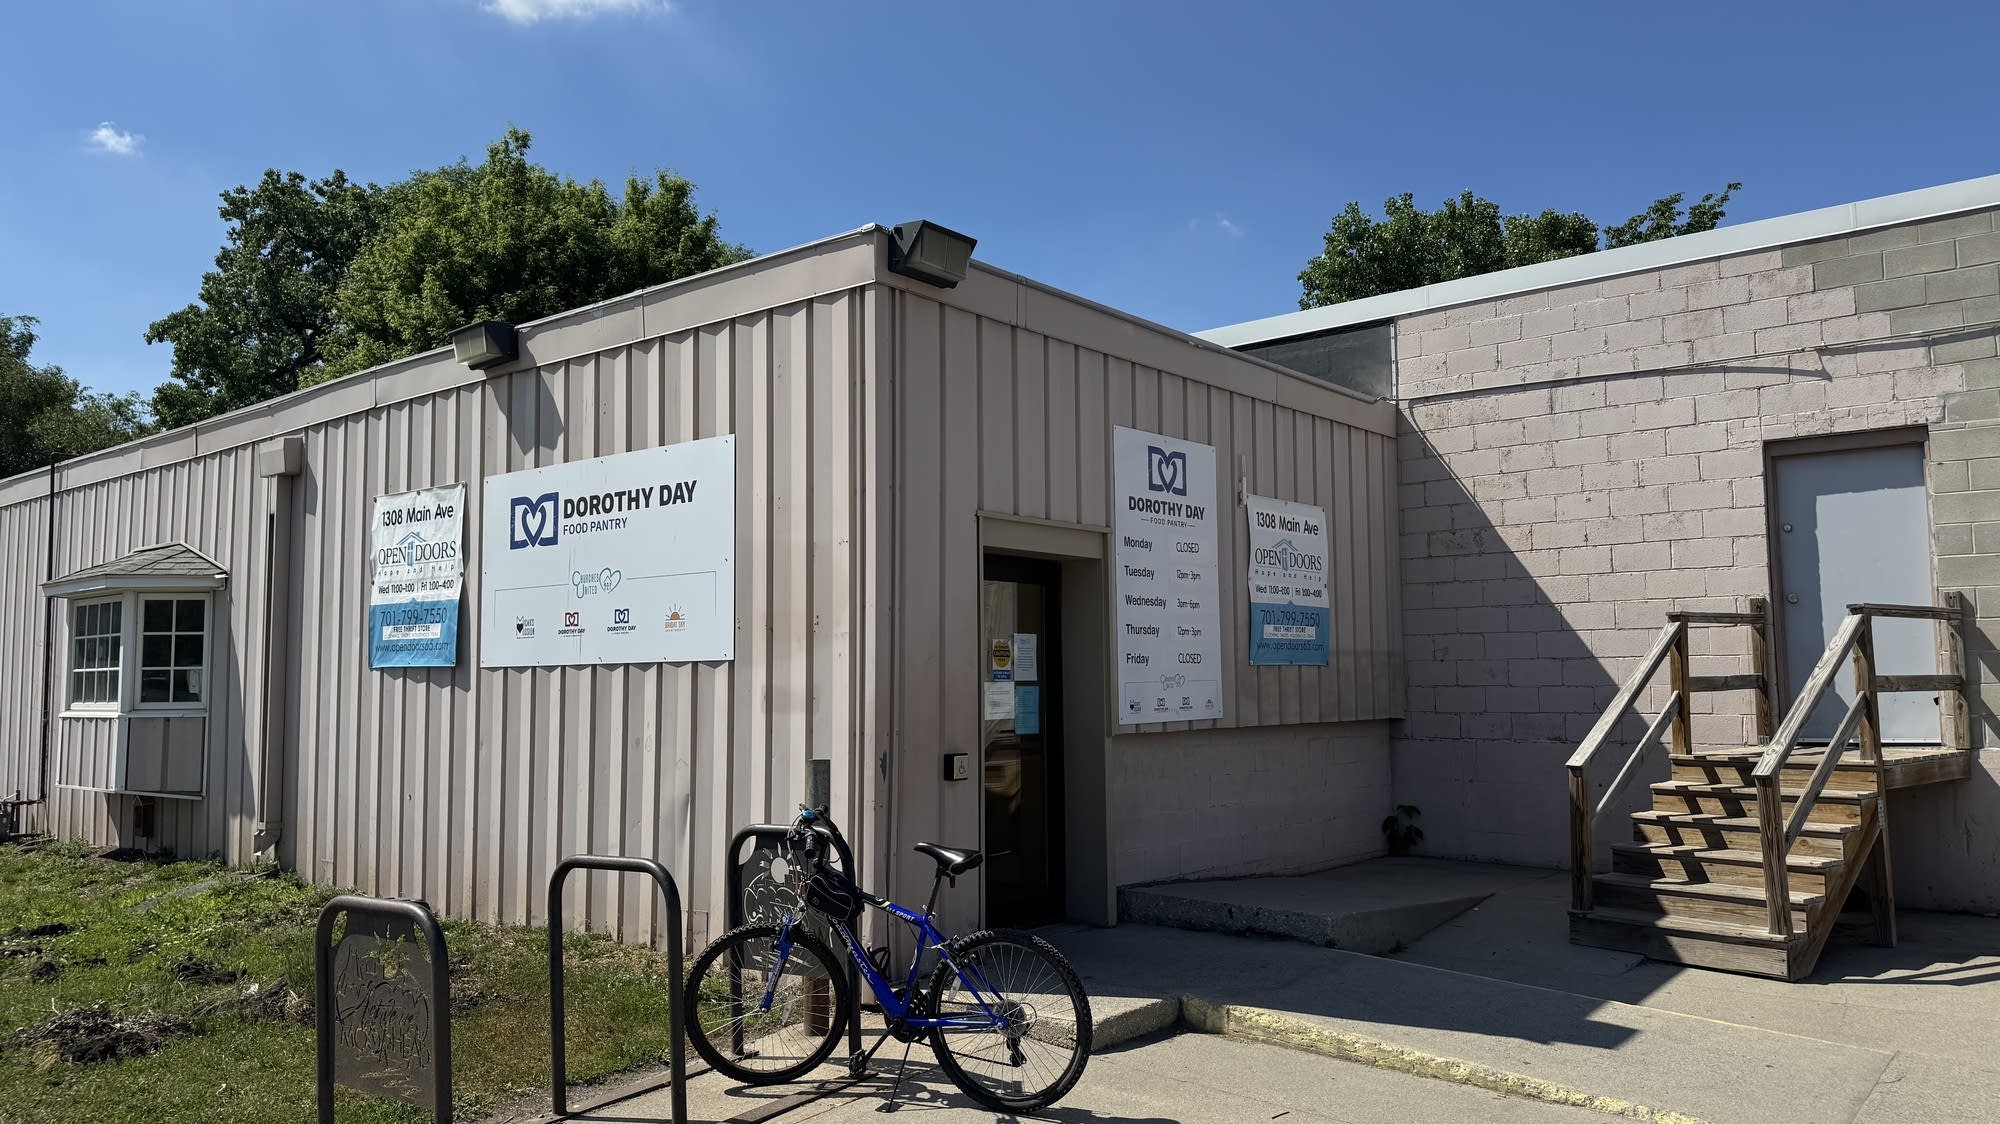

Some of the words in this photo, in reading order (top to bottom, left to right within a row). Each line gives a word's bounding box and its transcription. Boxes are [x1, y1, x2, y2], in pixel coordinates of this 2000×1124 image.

[563, 486, 654, 519] DOROTHY
[659, 480, 697, 507] DAY
[382, 509, 403, 527] 1308
[406, 505, 431, 523] Main
[434, 503, 454, 519] Ave
[1128, 496, 1183, 517] DOROTHY
[1185, 505, 1205, 521] DAY
[563, 522, 588, 535] FOOD
[590, 517, 628, 532] PANTRY
[1150, 517, 1165, 525] FOOD
[1167, 519, 1187, 528] PANTRY
[1256, 511, 1276, 529] 1308
[1278, 515, 1300, 533] Main
[1303, 520, 1319, 535] Ave
[378, 546, 407, 565] OPEN
[415, 540, 456, 561] DOORS
[1123, 536, 1153, 552] Monday
[1176, 542, 1200, 553] CLOSED
[1255, 547, 1282, 566] OPEN
[1289, 552, 1322, 571] DOORS
[1124, 565, 1155, 580] Tuesday
[1176, 569, 1201, 582] 12pm-3pm
[378, 585, 389, 594] Wed
[576, 584, 598, 599] UNITED
[1255, 584, 1267, 594] Wed
[1125, 594, 1167, 610] Wednesday
[1177, 598, 1201, 611] 3pm-6pm
[380, 607, 448, 626] 701-799-7550
[1260, 609, 1321, 628] 701-799-7550
[1126, 623, 1160, 638] Thursday
[1126, 652, 1150, 667] Friday
[1177, 653, 1202, 664] CLOSED
[895, 910, 916, 922] SPORT
[828, 914, 874, 985] oadmaster
